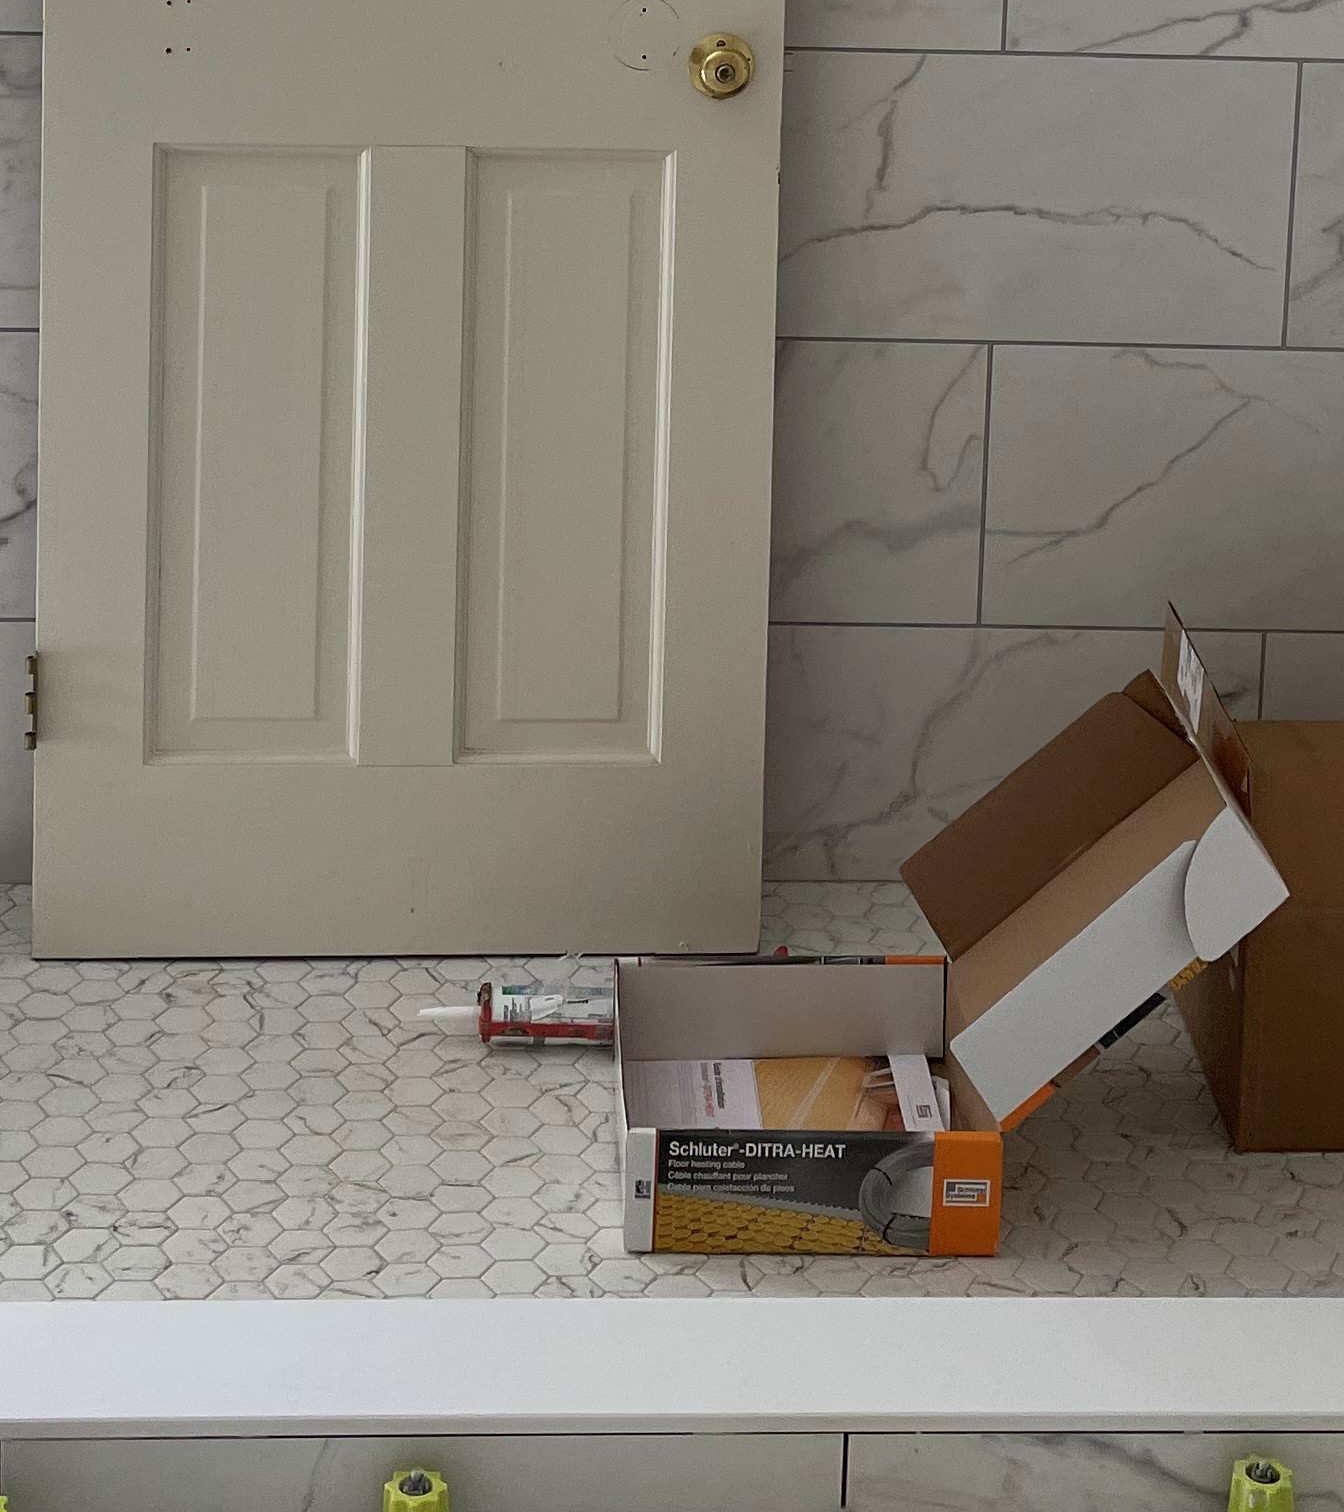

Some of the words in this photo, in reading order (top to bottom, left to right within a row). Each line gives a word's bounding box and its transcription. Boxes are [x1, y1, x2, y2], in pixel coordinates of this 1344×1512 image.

[667, 1159, 690, 1168] Floor
[690, 1159, 722, 1170] heating
[722, 1160, 746, 1169] cable
[732, 1173, 752, 1182] pour
